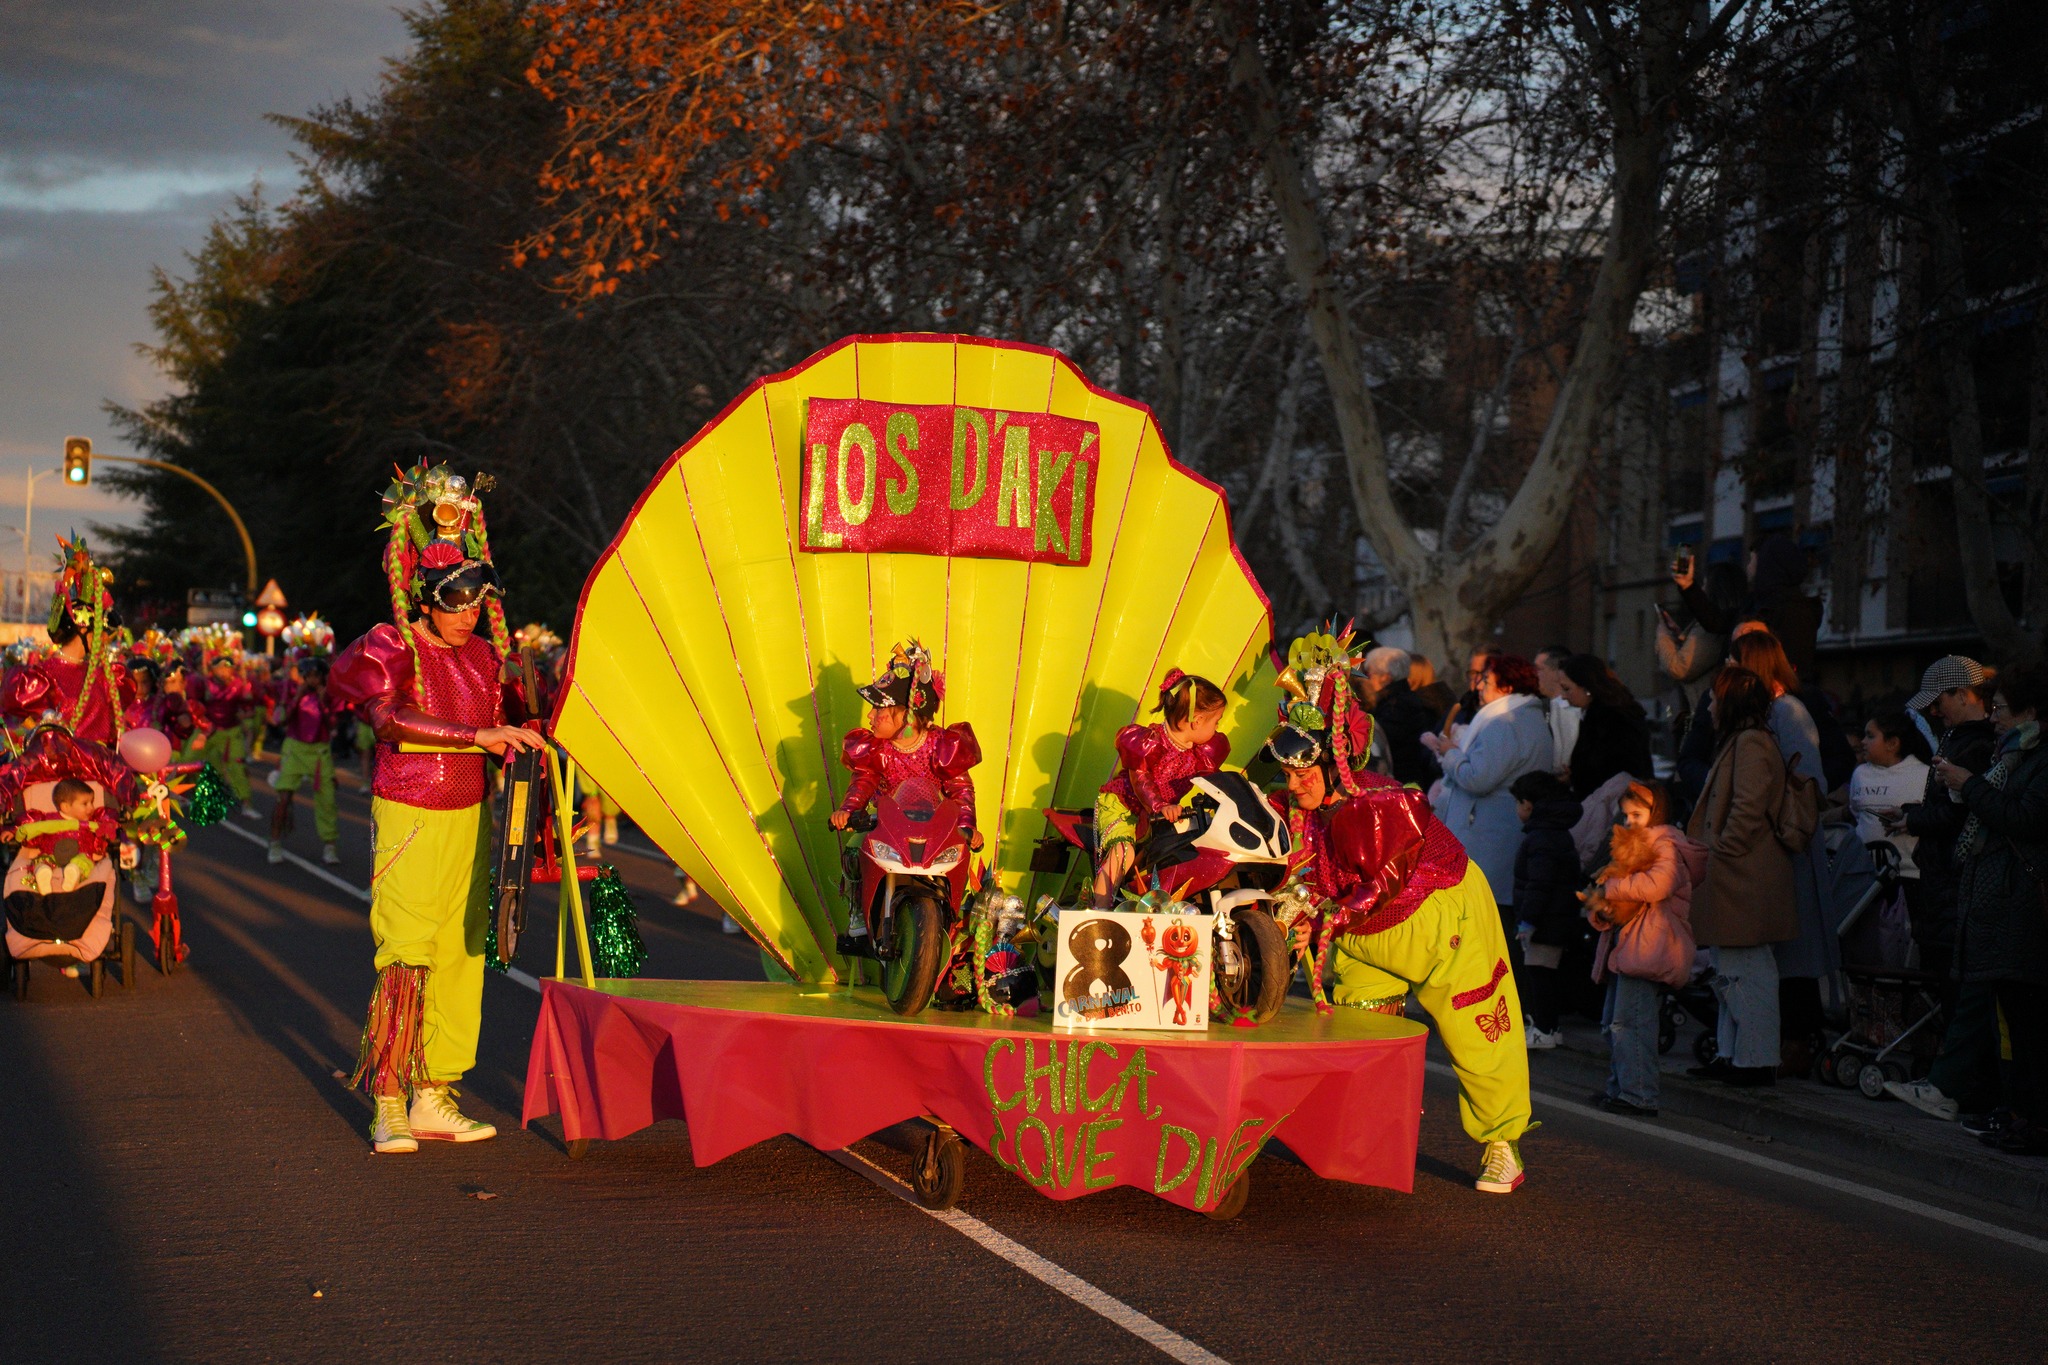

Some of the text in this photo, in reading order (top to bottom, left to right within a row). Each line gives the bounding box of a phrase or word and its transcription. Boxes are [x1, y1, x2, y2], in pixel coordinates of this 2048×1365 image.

[807, 412, 919, 548] LOS
[1058, 986, 1140, 1018] CARNAVAL
[1063, 918, 1132, 1018] 8
[1108, 1002, 1142, 1018] BENITO
[983, 1038, 1163, 1120] CHICA,
